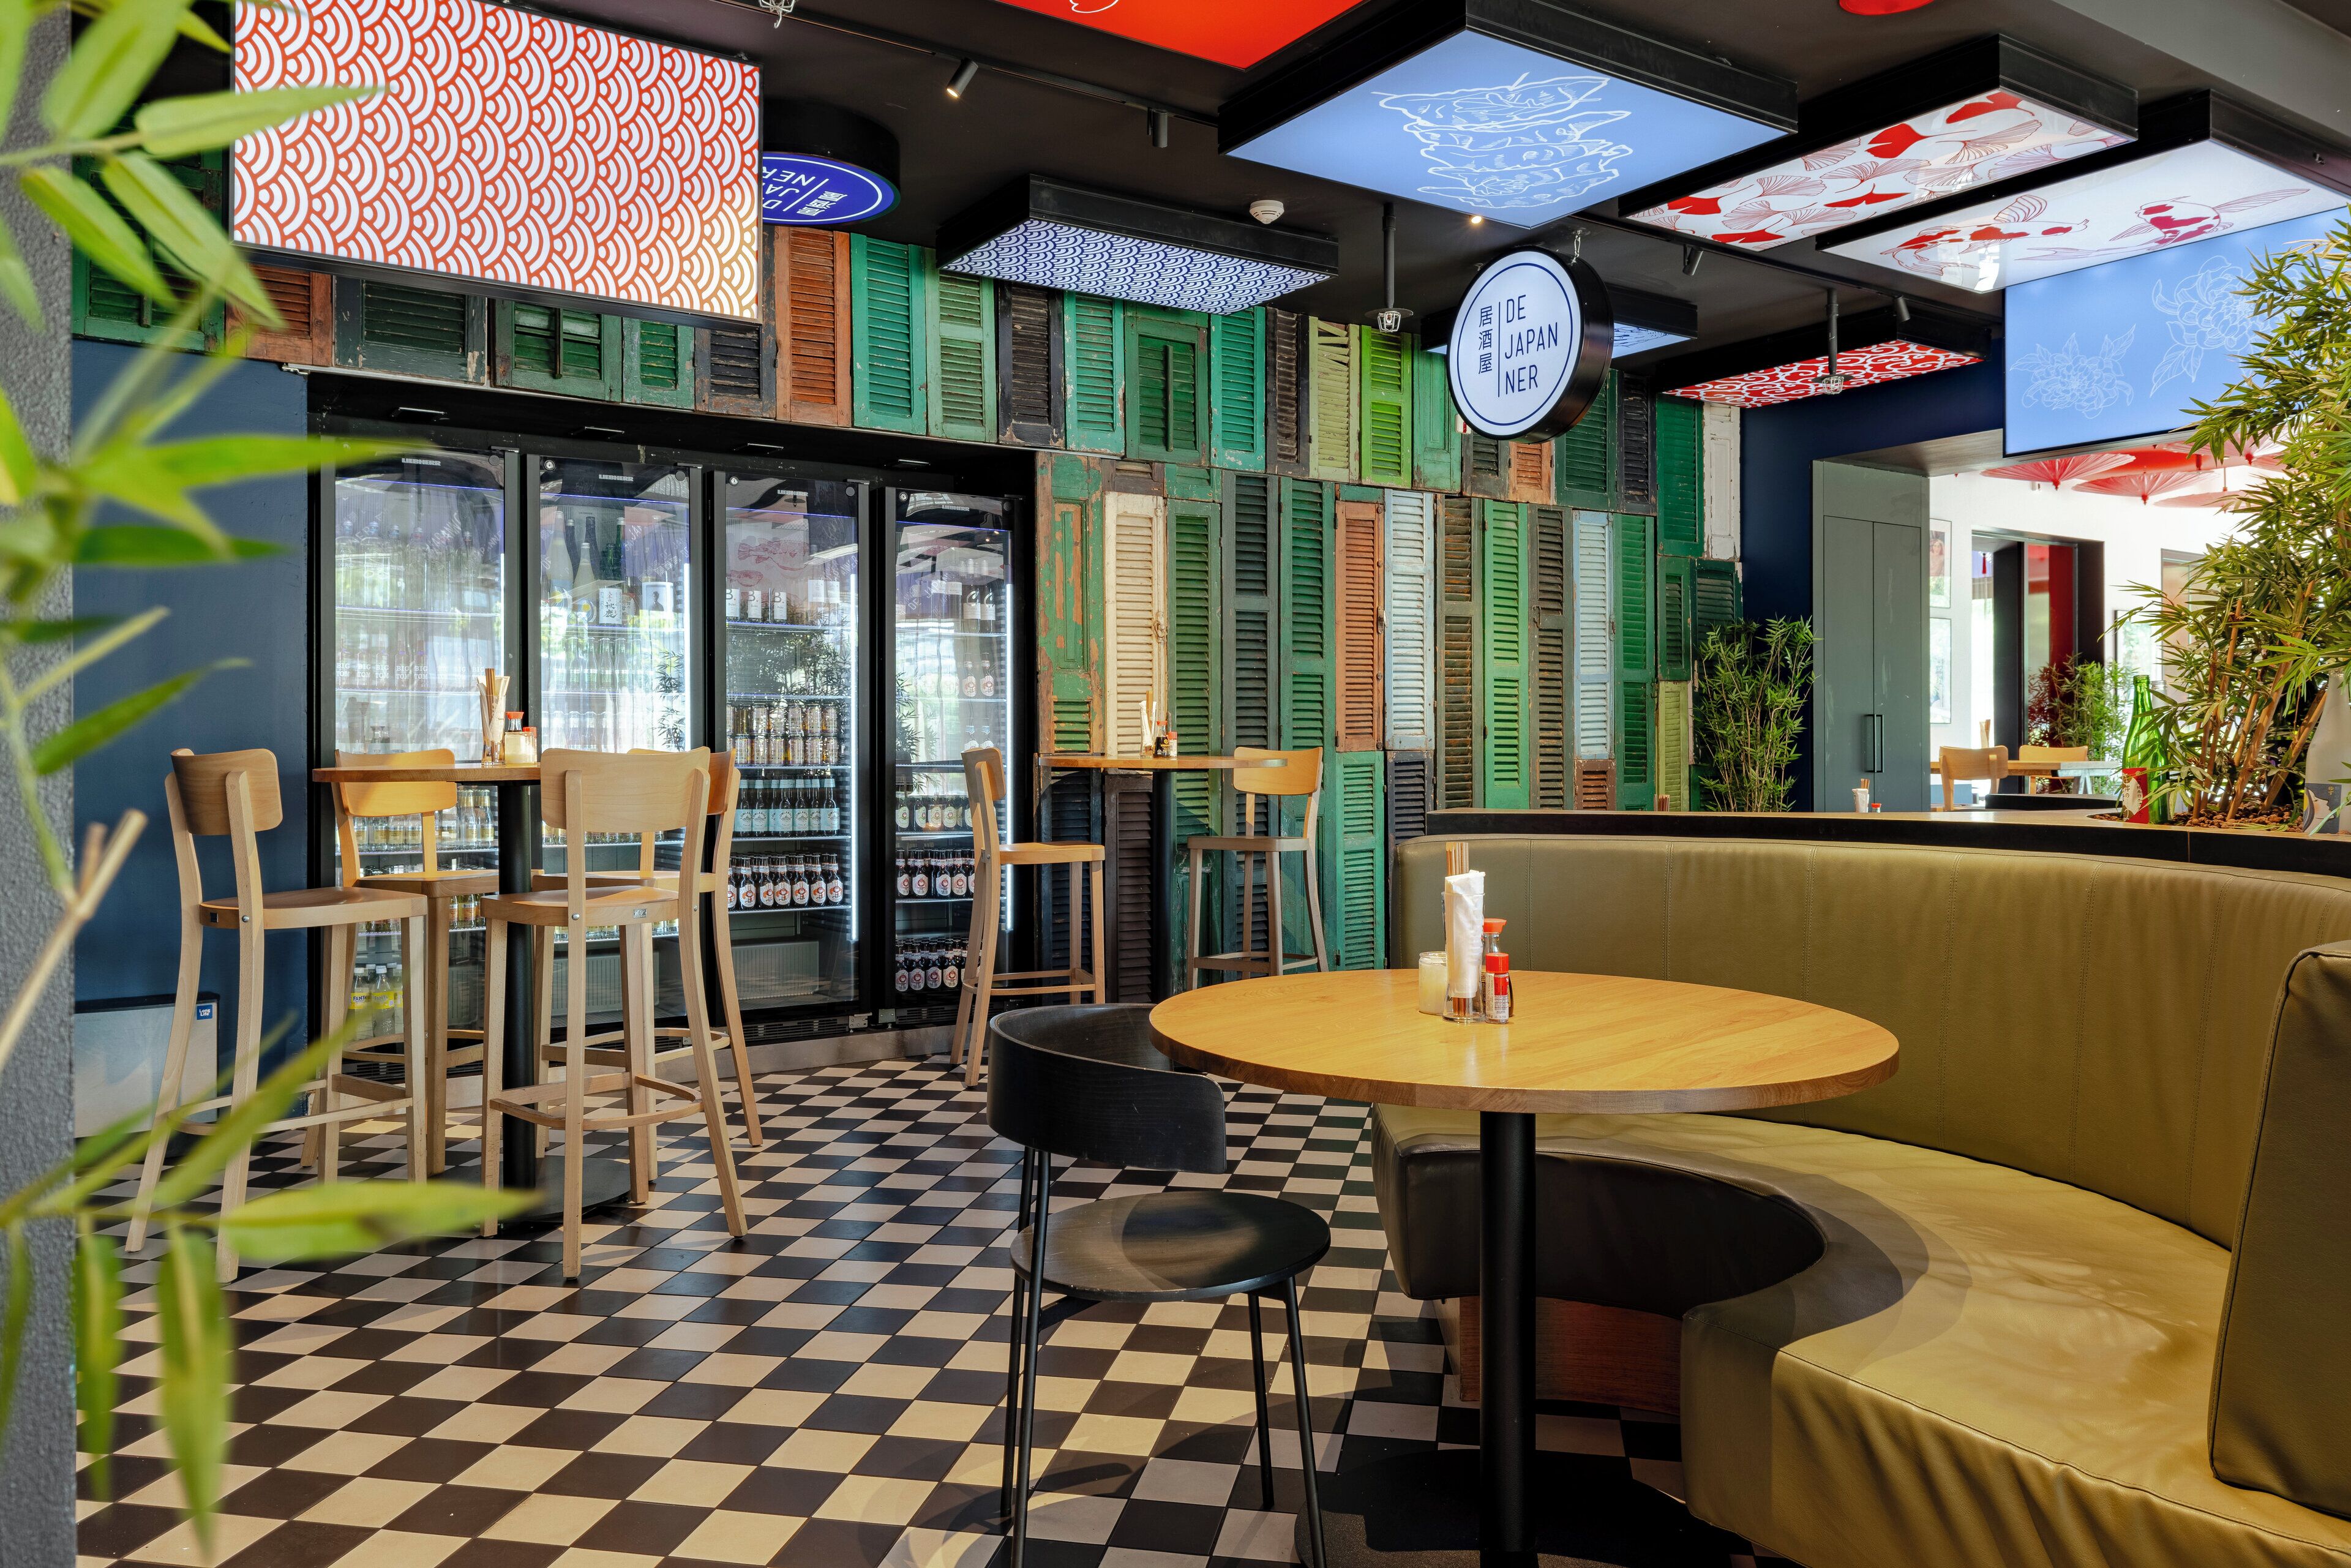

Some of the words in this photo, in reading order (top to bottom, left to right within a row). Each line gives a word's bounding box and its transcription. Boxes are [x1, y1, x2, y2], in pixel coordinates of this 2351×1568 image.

[763, 198, 782, 209] D
[797, 190, 848, 216] 居酒屋
[1506, 294, 1526, 323] DE
[1478, 305, 1493, 375] 居酒屋
[1504, 321, 1558, 359] JAPAN
[1505, 364, 1539, 395] NER
[402, 457, 441, 467] LIEBHERR
[942, 504, 970, 512] LIEBHERR
